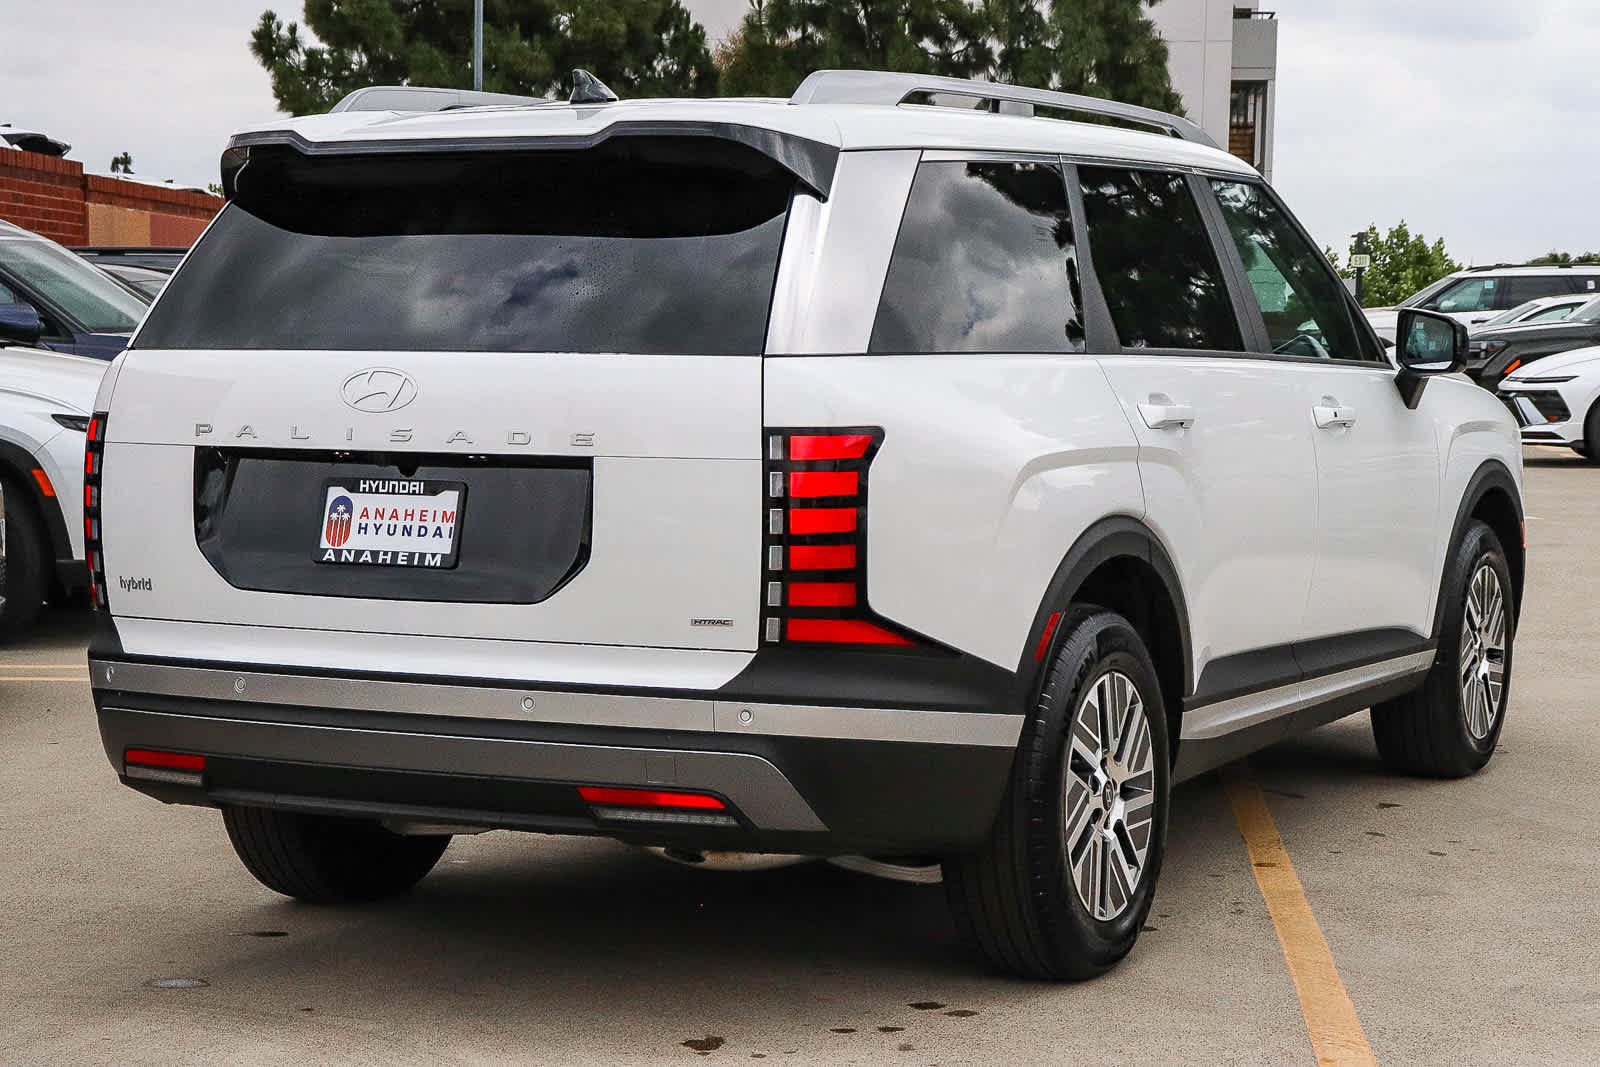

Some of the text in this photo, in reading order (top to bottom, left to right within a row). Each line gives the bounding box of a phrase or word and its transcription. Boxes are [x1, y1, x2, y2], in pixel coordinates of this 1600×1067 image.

[195, 423, 595, 447] PALISADE
[359, 479, 425, 494] HYUNDAI
[359, 507, 456, 523] ANAHEIM
[357, 522, 454, 539] HYUNDAI
[322, 549, 442, 567] ANAHEIM
[119, 575, 153, 592] hybrid
[692, 618, 732, 626] HTRAC
